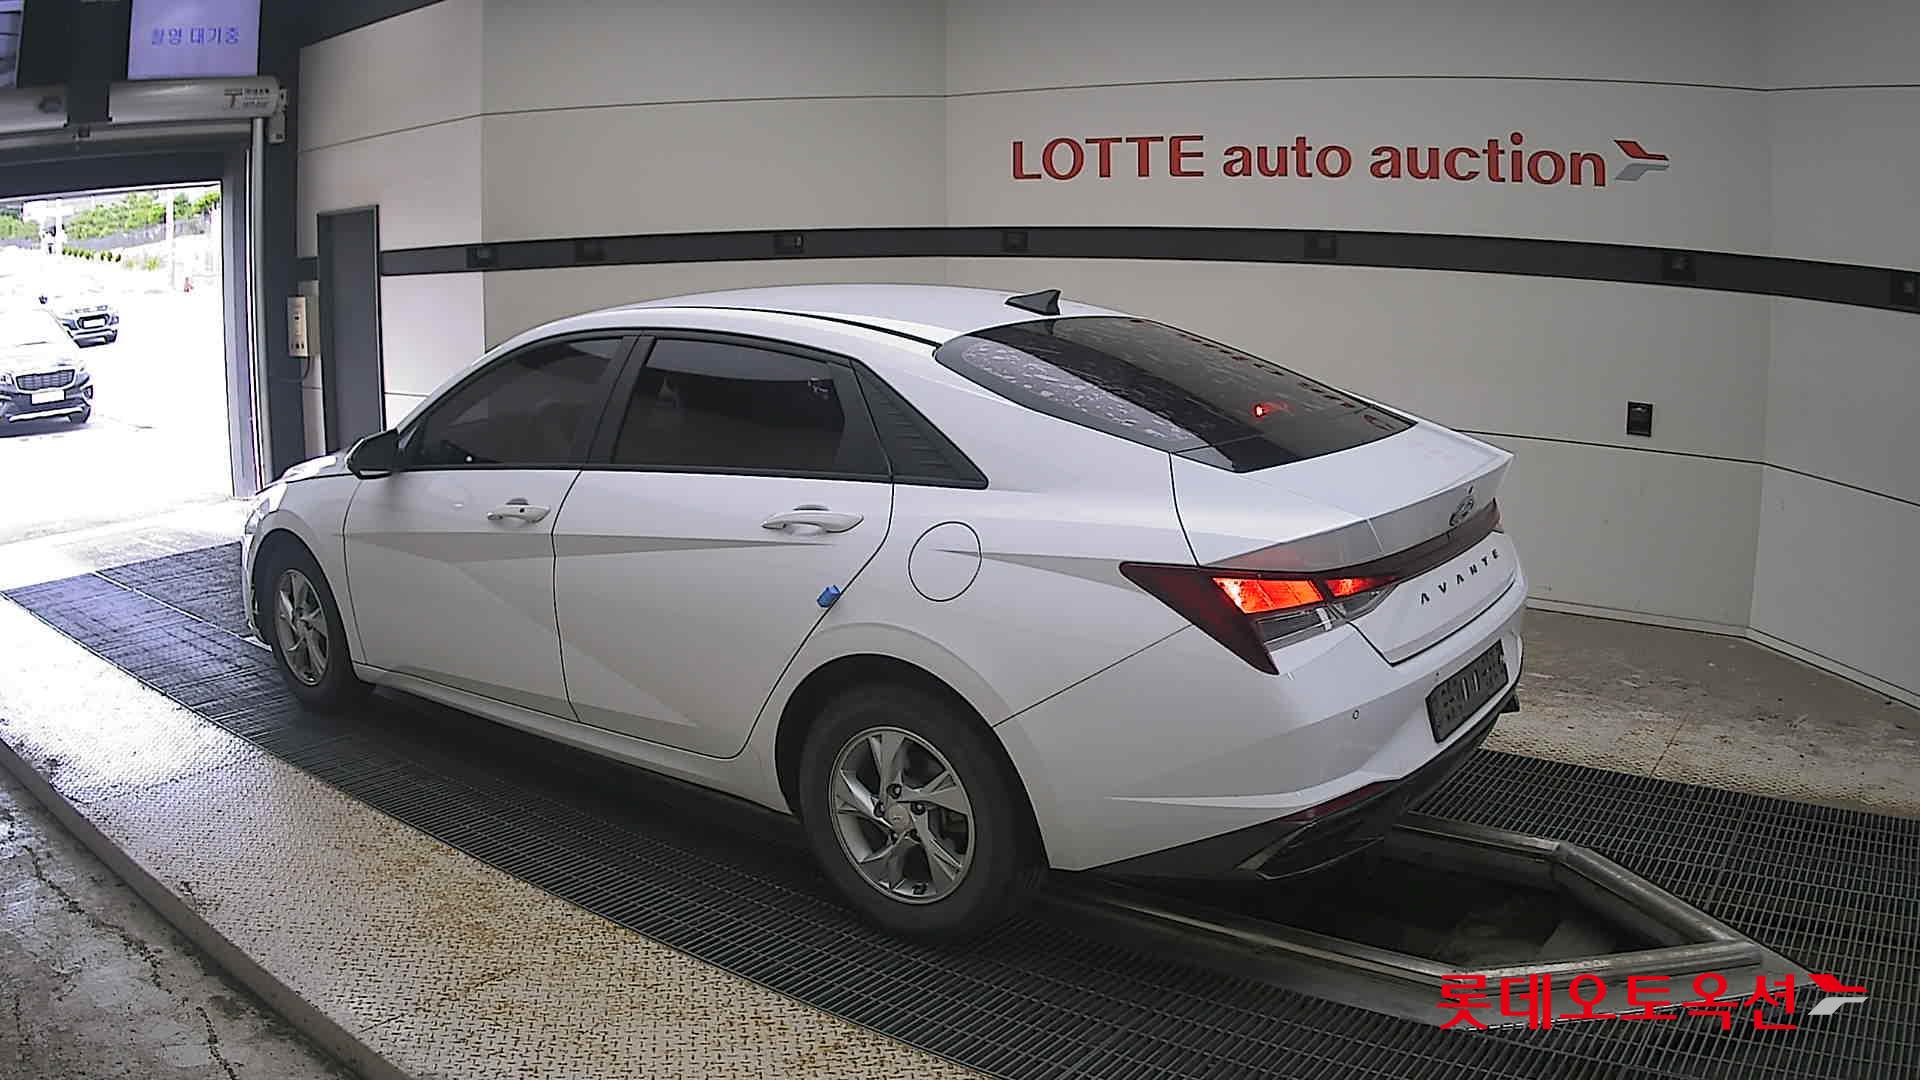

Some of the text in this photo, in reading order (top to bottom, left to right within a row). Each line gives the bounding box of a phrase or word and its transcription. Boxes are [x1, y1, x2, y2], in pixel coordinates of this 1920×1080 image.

[189, 26, 240, 46] 대기중
[1012, 131, 1607, 187] LOTTE auto auction
[1419, 548, 1500, 605] AVANTE
